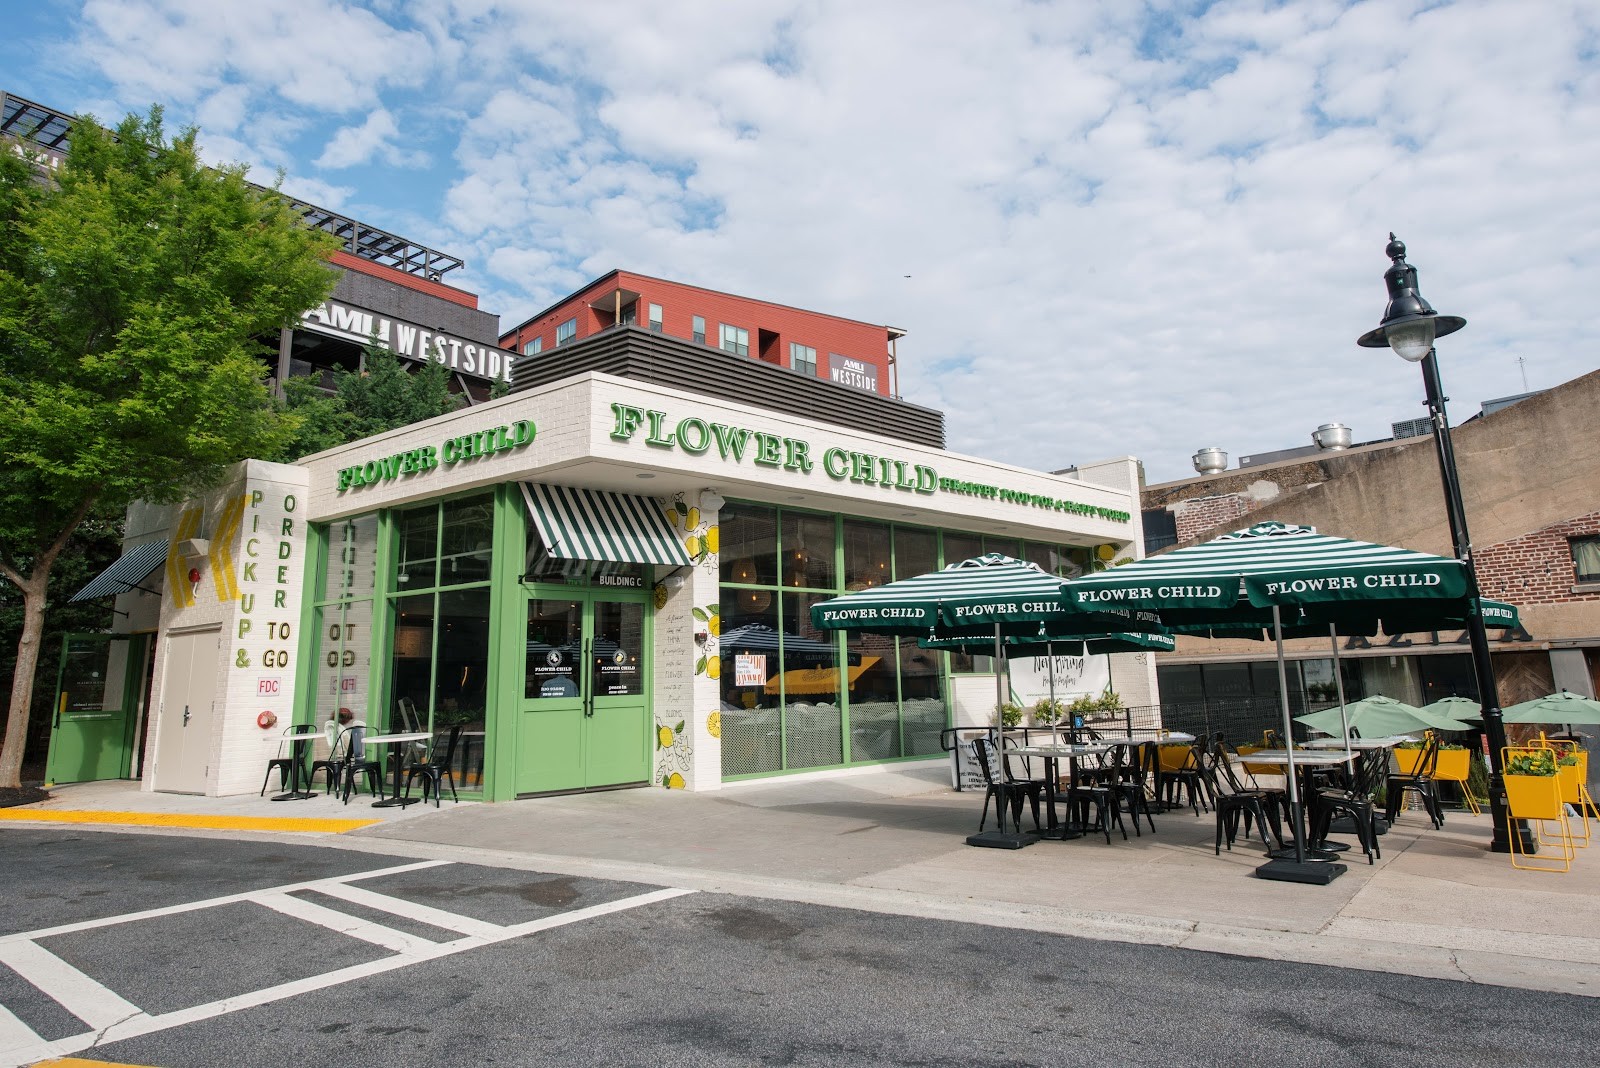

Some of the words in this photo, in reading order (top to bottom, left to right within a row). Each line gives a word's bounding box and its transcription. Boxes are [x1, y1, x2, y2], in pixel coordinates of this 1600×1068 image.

[301, 303, 390, 341] AMLI
[397, 324, 514, 382] WESTSIDE
[844, 360, 865, 371] AMLI
[832, 368, 876, 391] WESTSIDE
[336, 446, 438, 491] FLOWER
[442, 419, 536, 463] CHILD
[610, 402, 814, 472] FLOWER
[823, 447, 939, 494] CHILD
[939, 477, 999, 497] HEALTHY
[1000, 488, 1031, 502] FOOD
[1064, 500, 1098, 516] HAPPY
[1098, 507, 1131, 522] WORLD
[244, 490, 264, 582] PICK
[275, 495, 297, 608] ORDER
[600, 575, 635, 587] BUILDING
[636, 578, 642, 587] C
[1266, 576, 1357, 595] FLOWER
[1363, 573, 1441, 588] CHILD
[1078, 588, 1154, 602] FLOWER
[1157, 586, 1222, 598] CHILD
[239, 594, 255, 639] UP
[823, 608, 878, 621] FLOWER
[880, 607, 926, 619] CHILD
[955, 603, 1018, 617] FLOWER
[1021, 601, 1066, 613] CHIL
[267, 622, 291, 640] TO
[236, 648, 251, 668] &
[263, 650, 289, 668] GO
[259, 681, 279, 692] FDC
